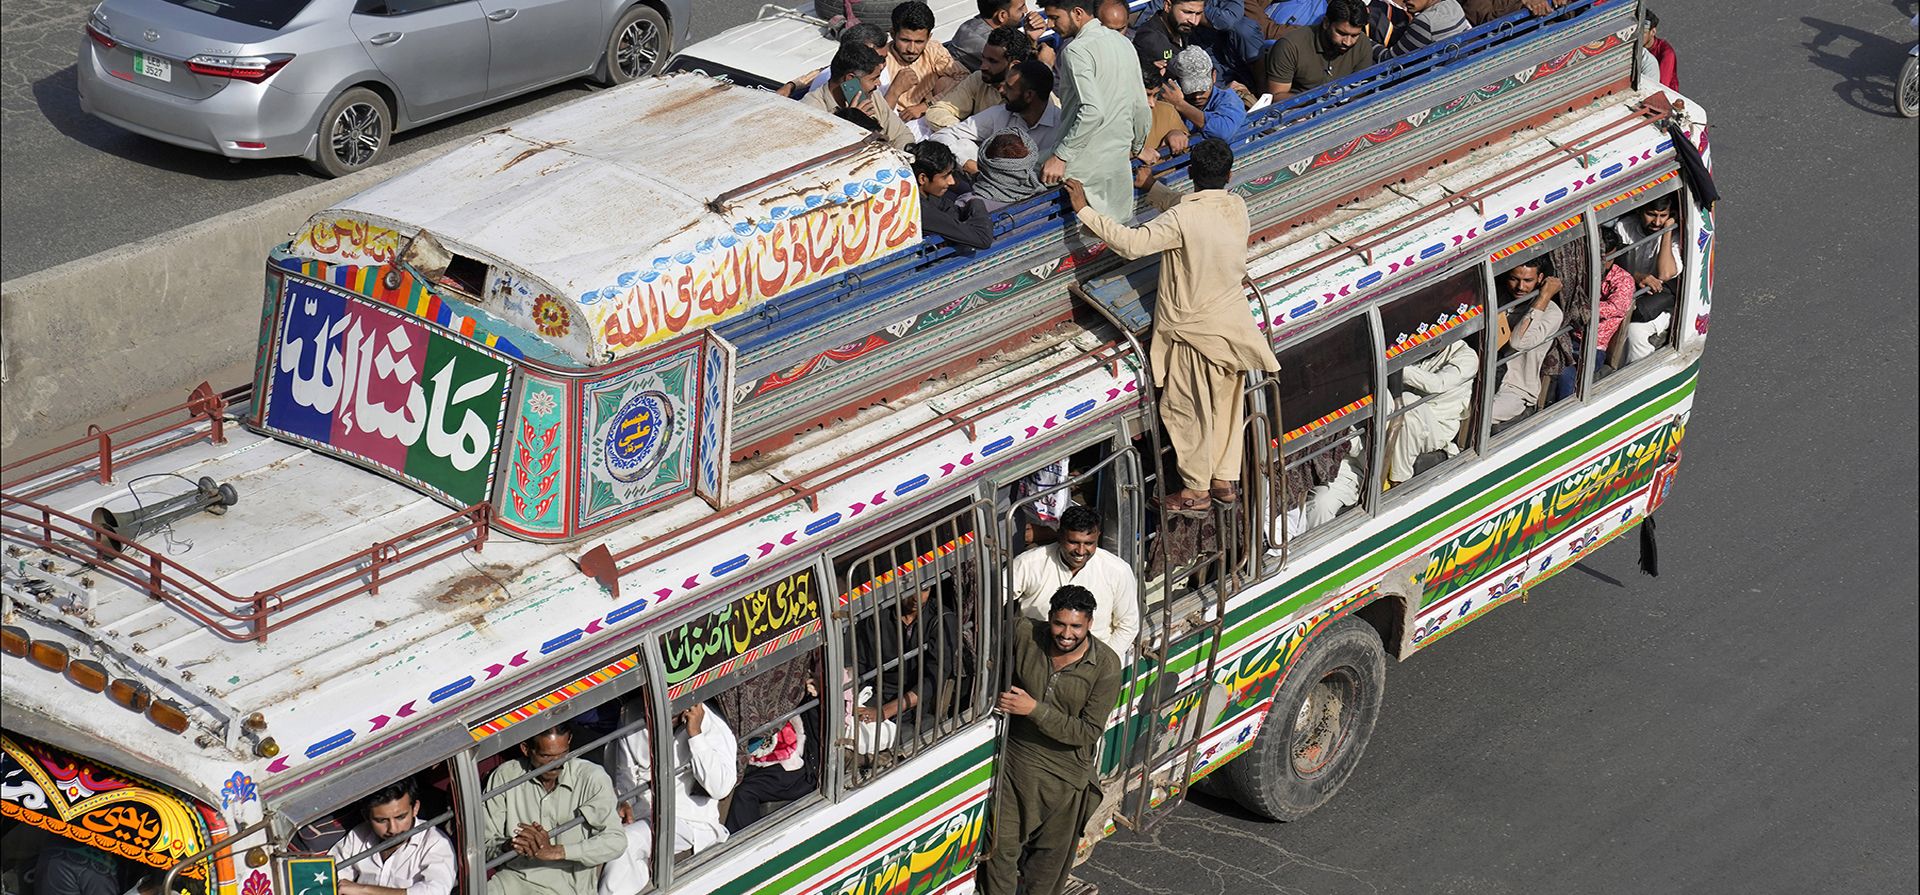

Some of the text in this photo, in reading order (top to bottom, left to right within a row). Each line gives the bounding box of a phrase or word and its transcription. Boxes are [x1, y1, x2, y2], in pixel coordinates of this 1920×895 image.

[145, 65, 163, 77] 3527
[698, 244, 751, 316] اللہ
[604, 283, 658, 348] اللہ
